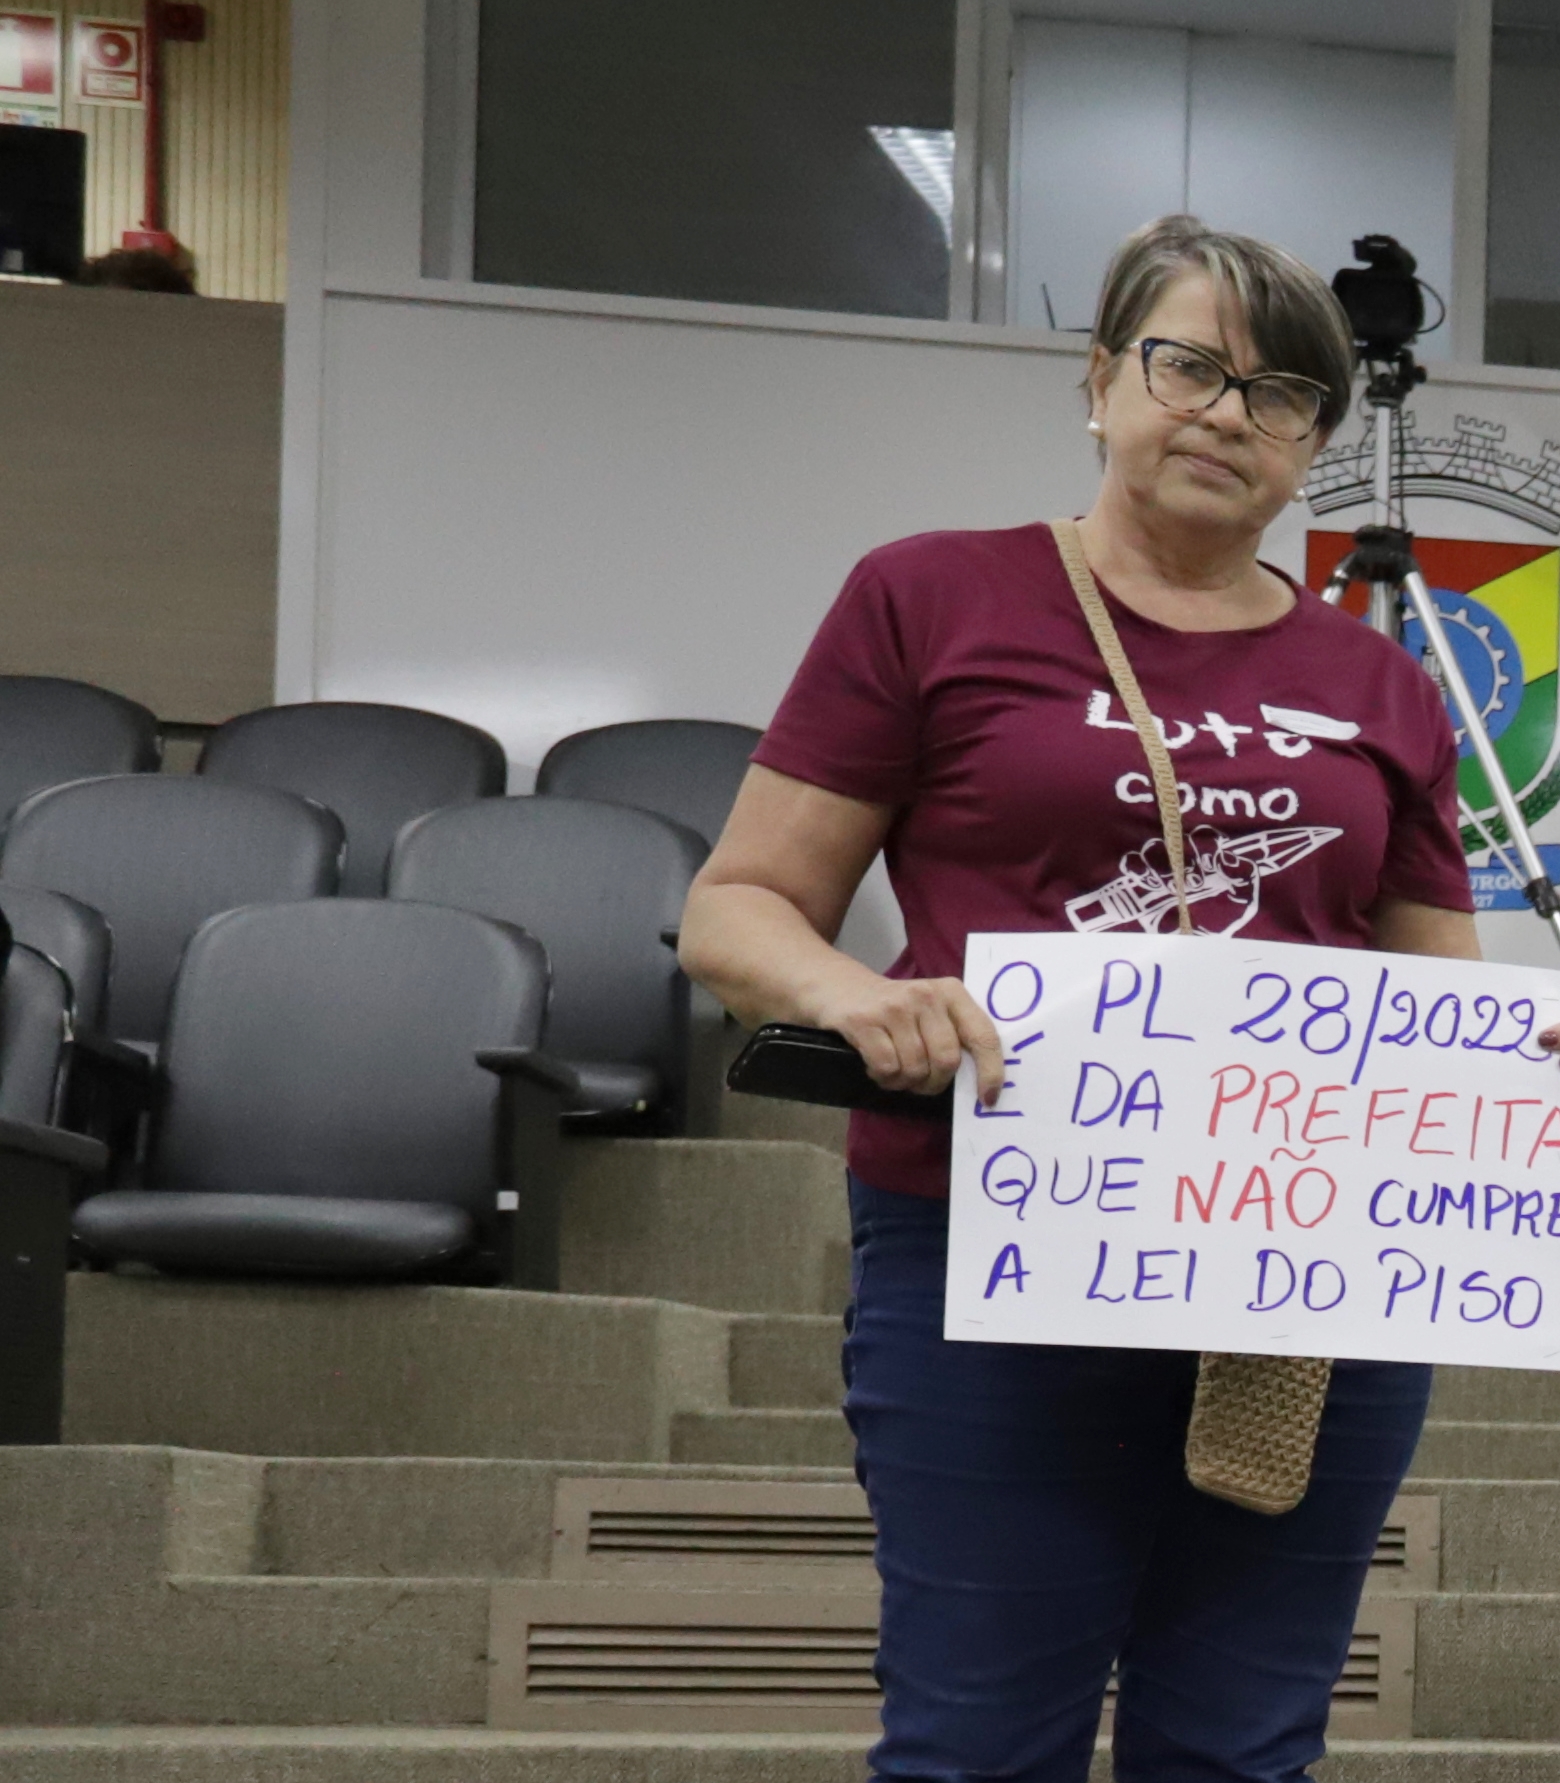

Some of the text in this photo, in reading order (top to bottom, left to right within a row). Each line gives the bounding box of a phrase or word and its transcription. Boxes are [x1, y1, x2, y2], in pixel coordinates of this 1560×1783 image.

[1115, 772, 1299, 821] como
[986, 959, 1554, 1085] O PL 28/2022
[973, 1030, 1045, 1119] É
[1072, 1060, 1164, 1131] DA
[981, 1146, 1145, 1221] QUE
[1173, 1147, 1337, 1231] NÃO
[984, 1241, 1544, 1329] A LEI DO PISO
